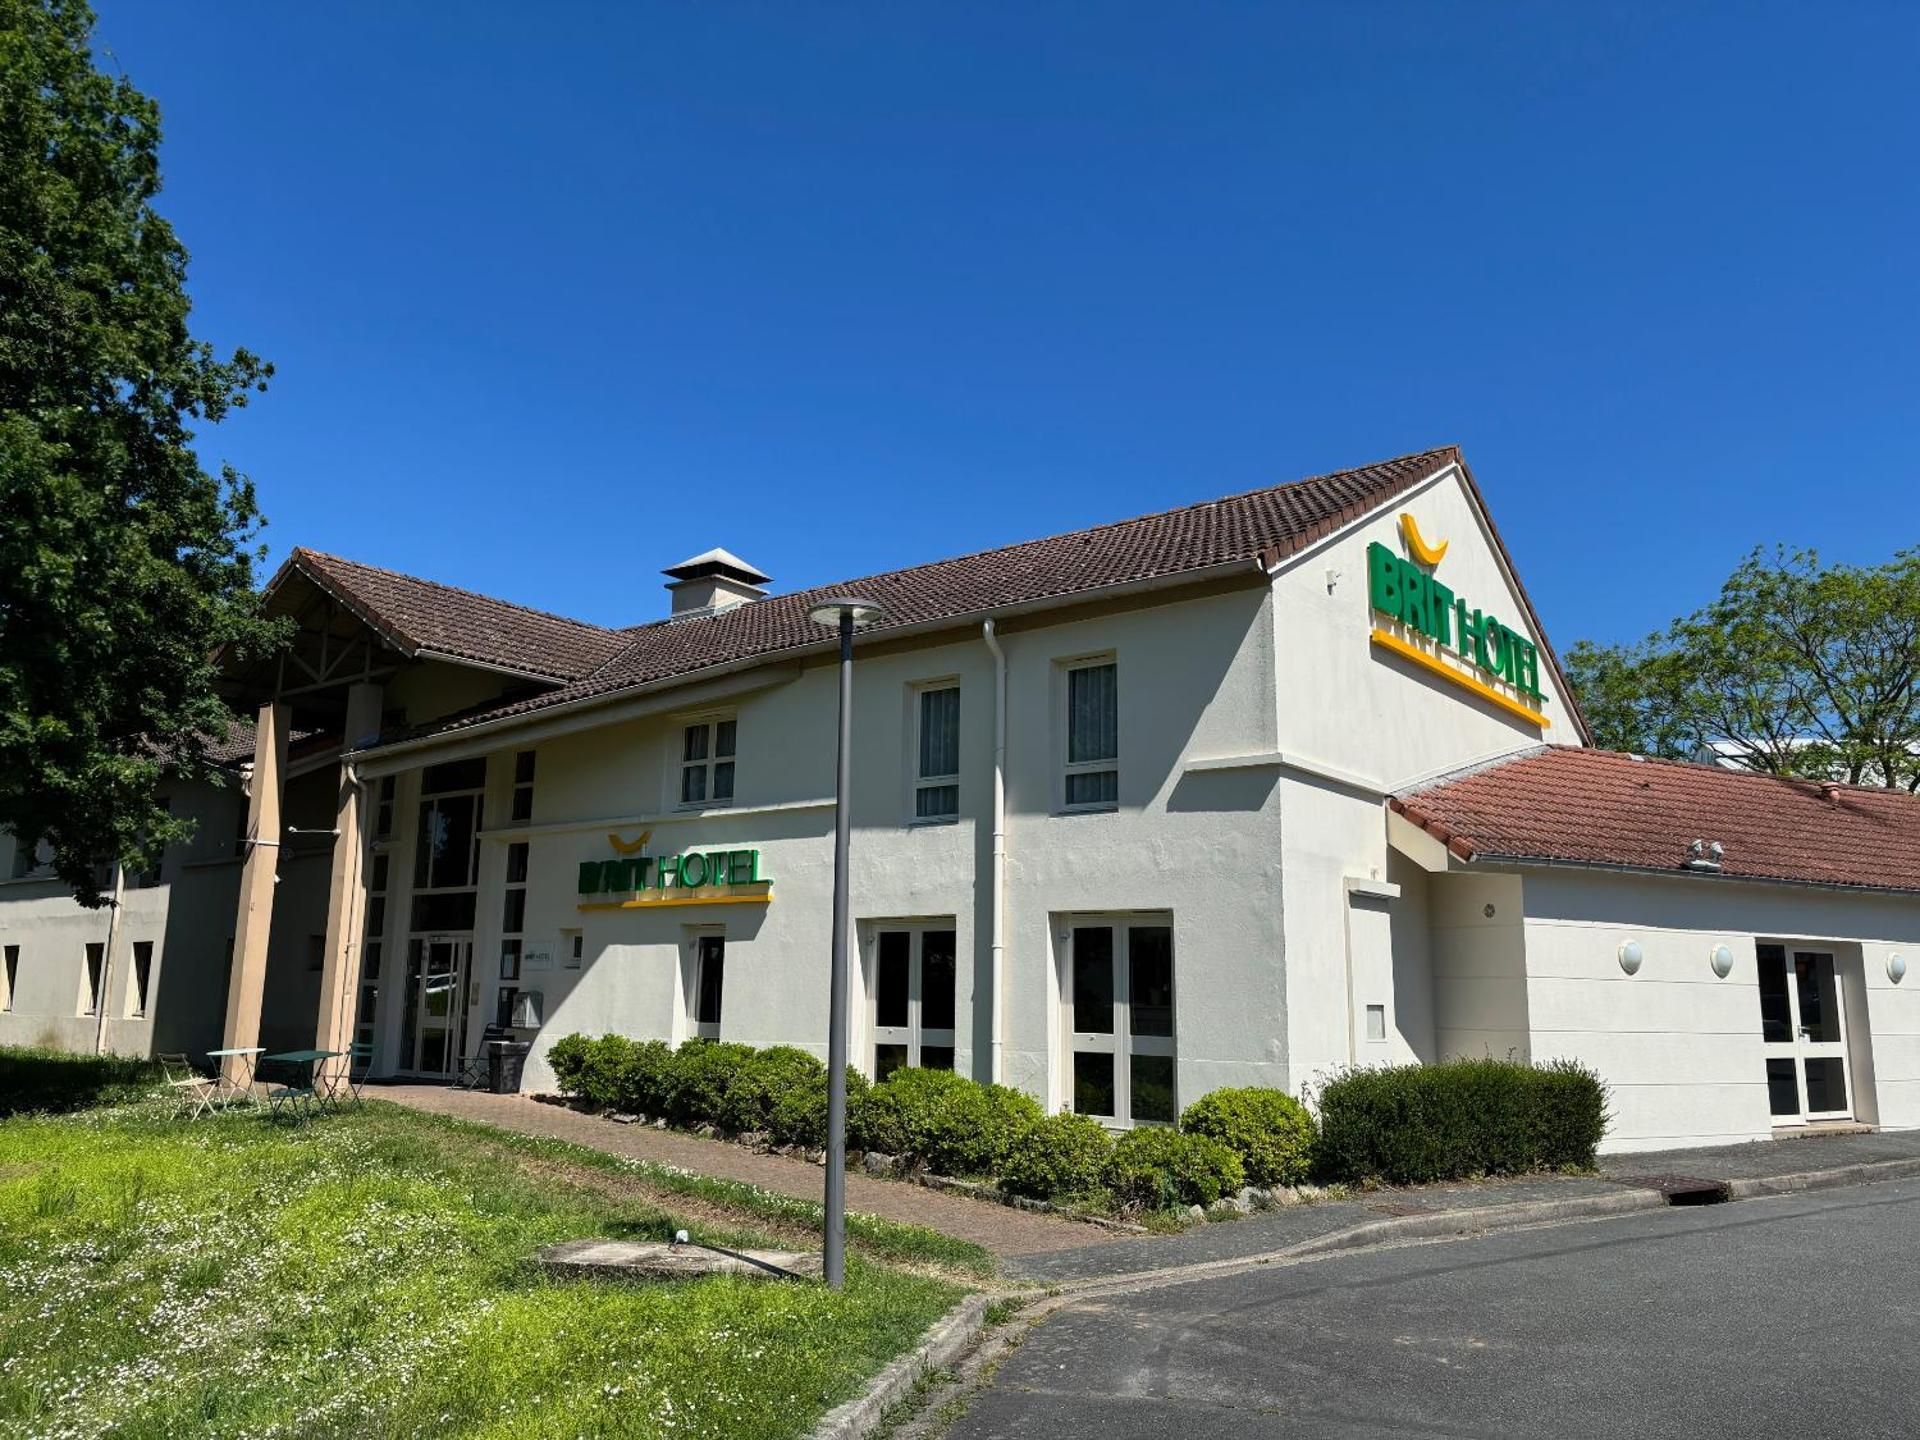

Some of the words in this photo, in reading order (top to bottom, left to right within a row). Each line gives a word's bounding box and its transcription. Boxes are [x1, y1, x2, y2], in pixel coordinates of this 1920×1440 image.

[1369, 541, 1455, 647] BRIT
[1457, 598, 1549, 702] HOTEL
[657, 849, 774, 889] HOTEL
